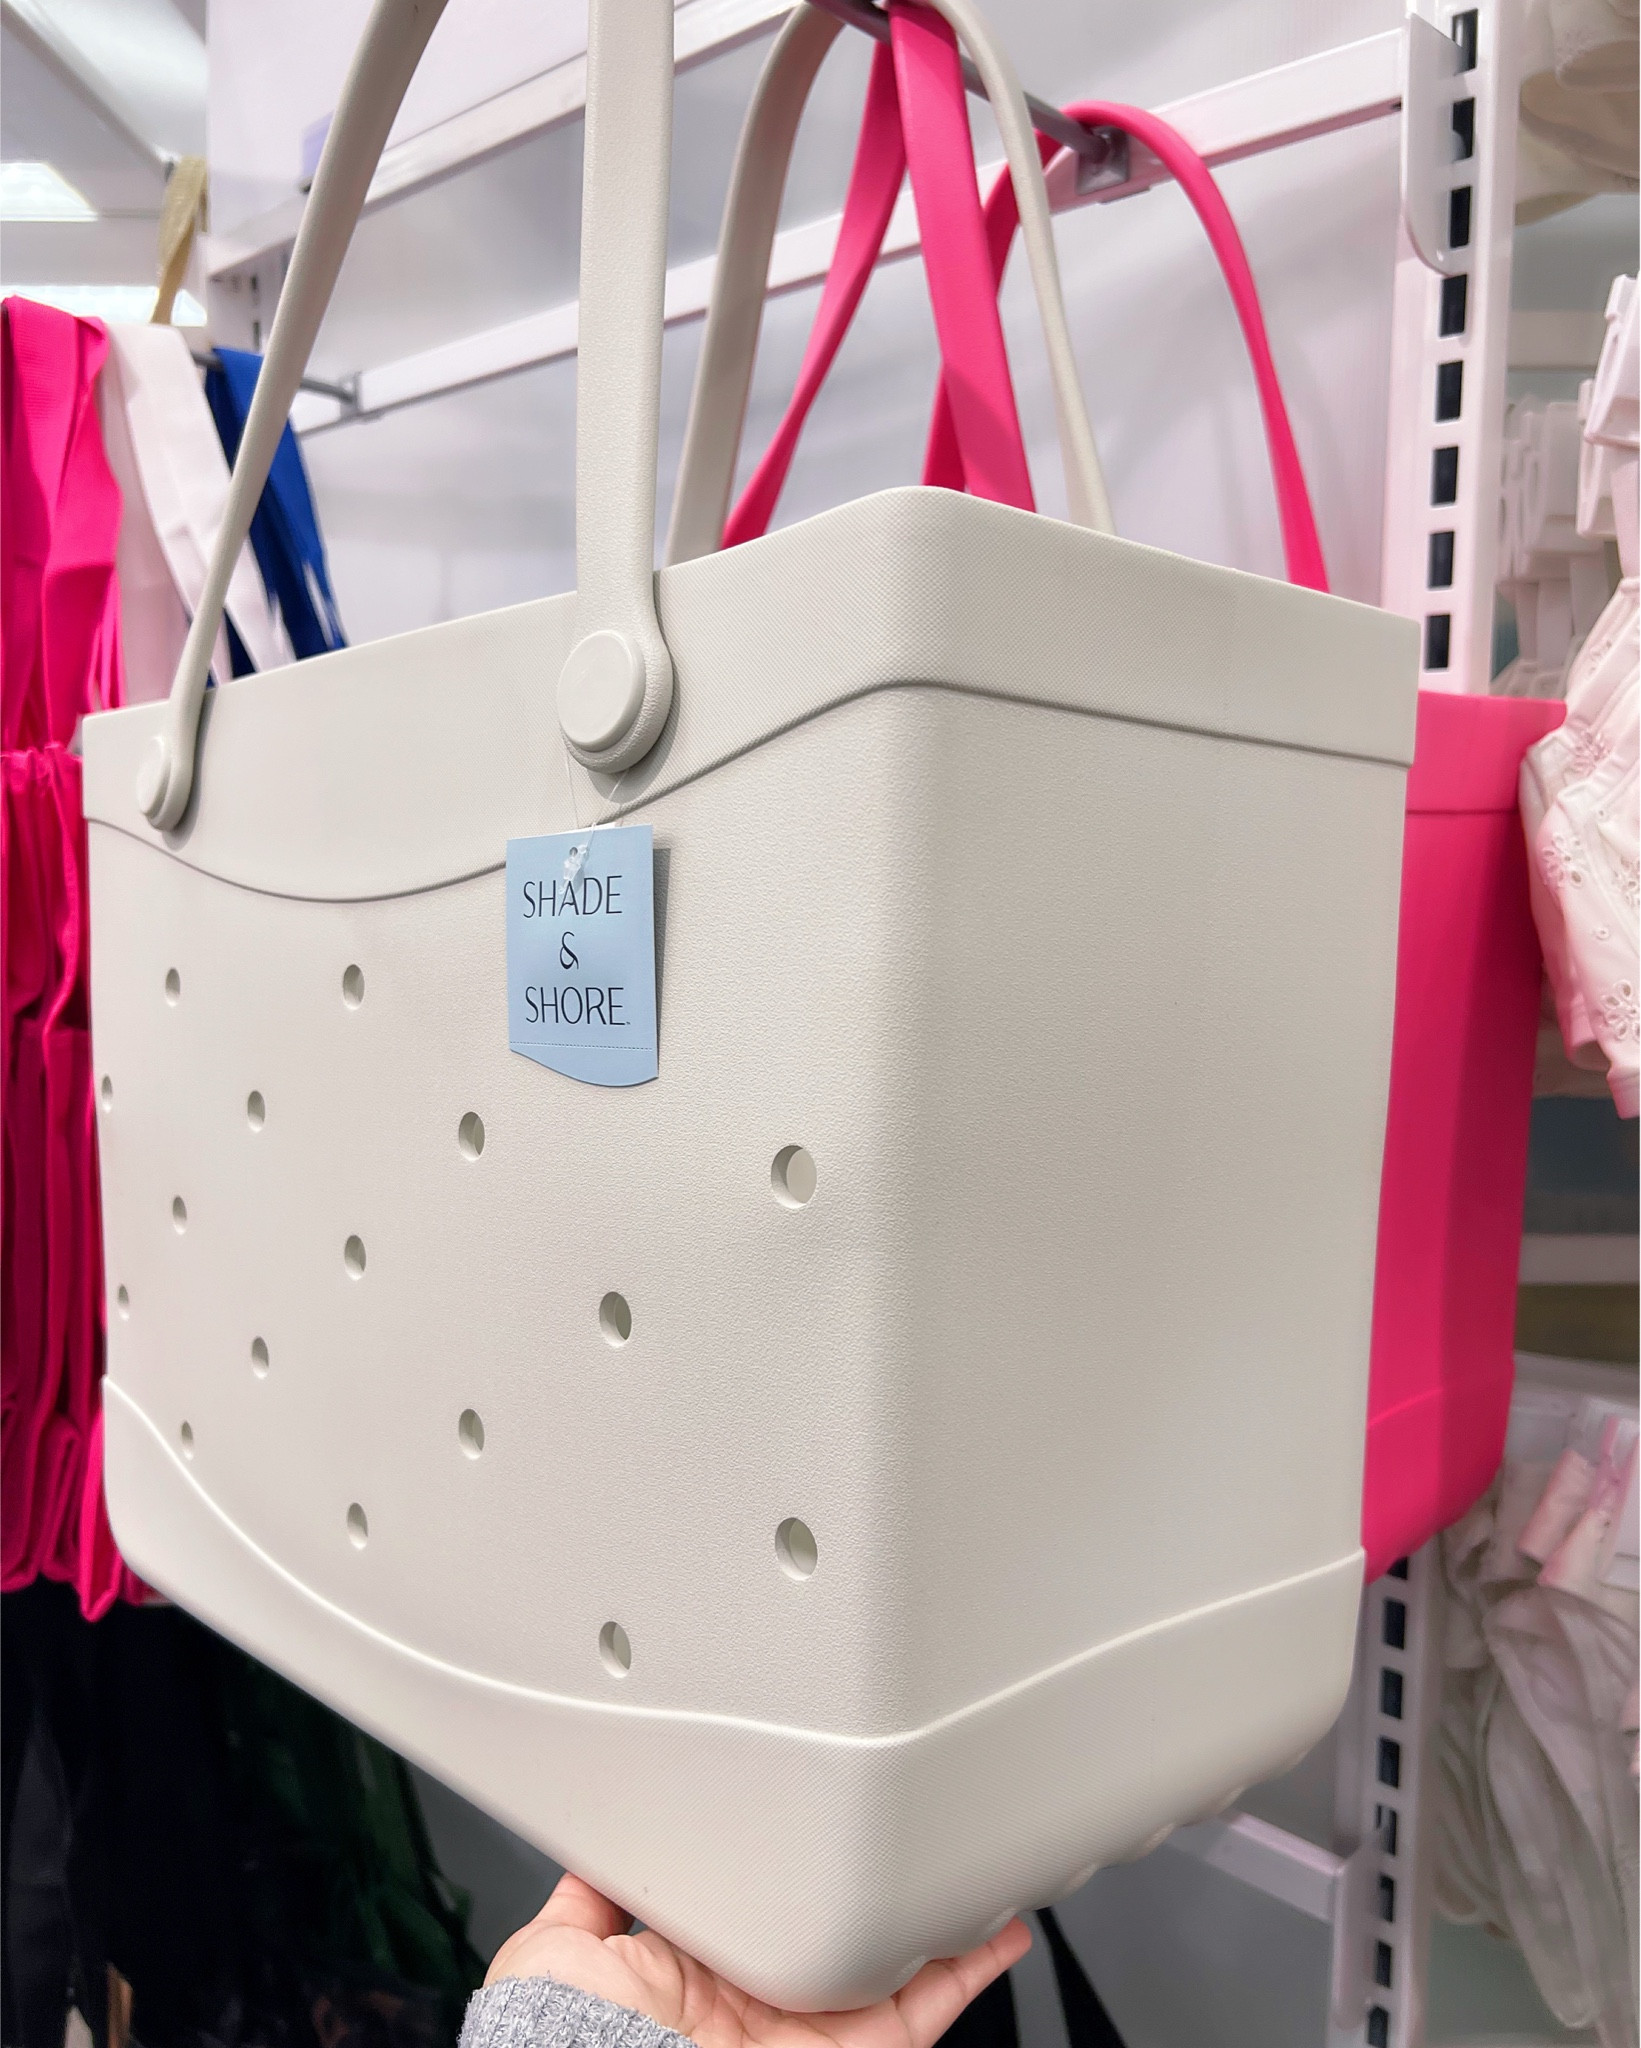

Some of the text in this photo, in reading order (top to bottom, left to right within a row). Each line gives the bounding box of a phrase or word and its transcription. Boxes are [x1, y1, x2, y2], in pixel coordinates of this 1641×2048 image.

[523, 875, 623, 918] SHADE
[559, 931, 579, 970] &
[525, 986, 627, 1025] SHORE
